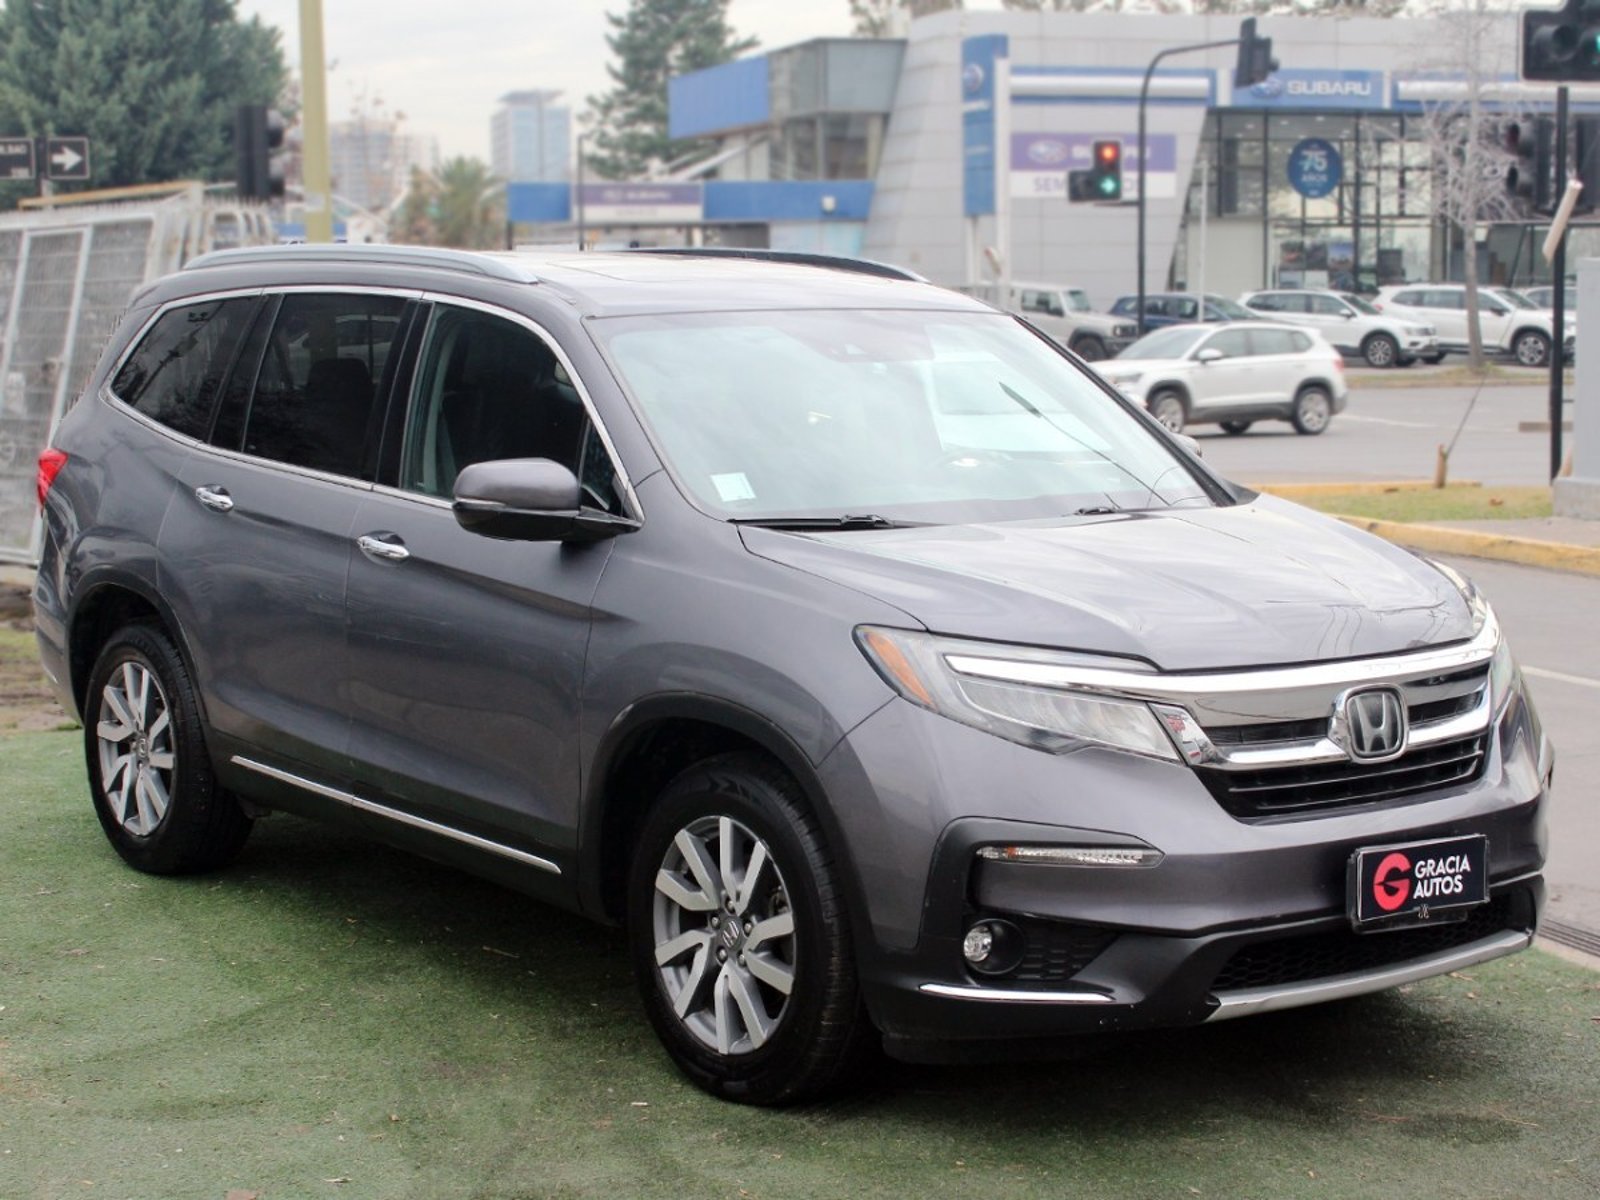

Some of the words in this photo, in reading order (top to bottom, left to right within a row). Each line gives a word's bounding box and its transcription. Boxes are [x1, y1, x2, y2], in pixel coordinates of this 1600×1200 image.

[1287, 80, 1371, 96] SUBARU
[1414, 853, 1472, 879] GRACIA
[1413, 874, 1464, 900] AUTOS
